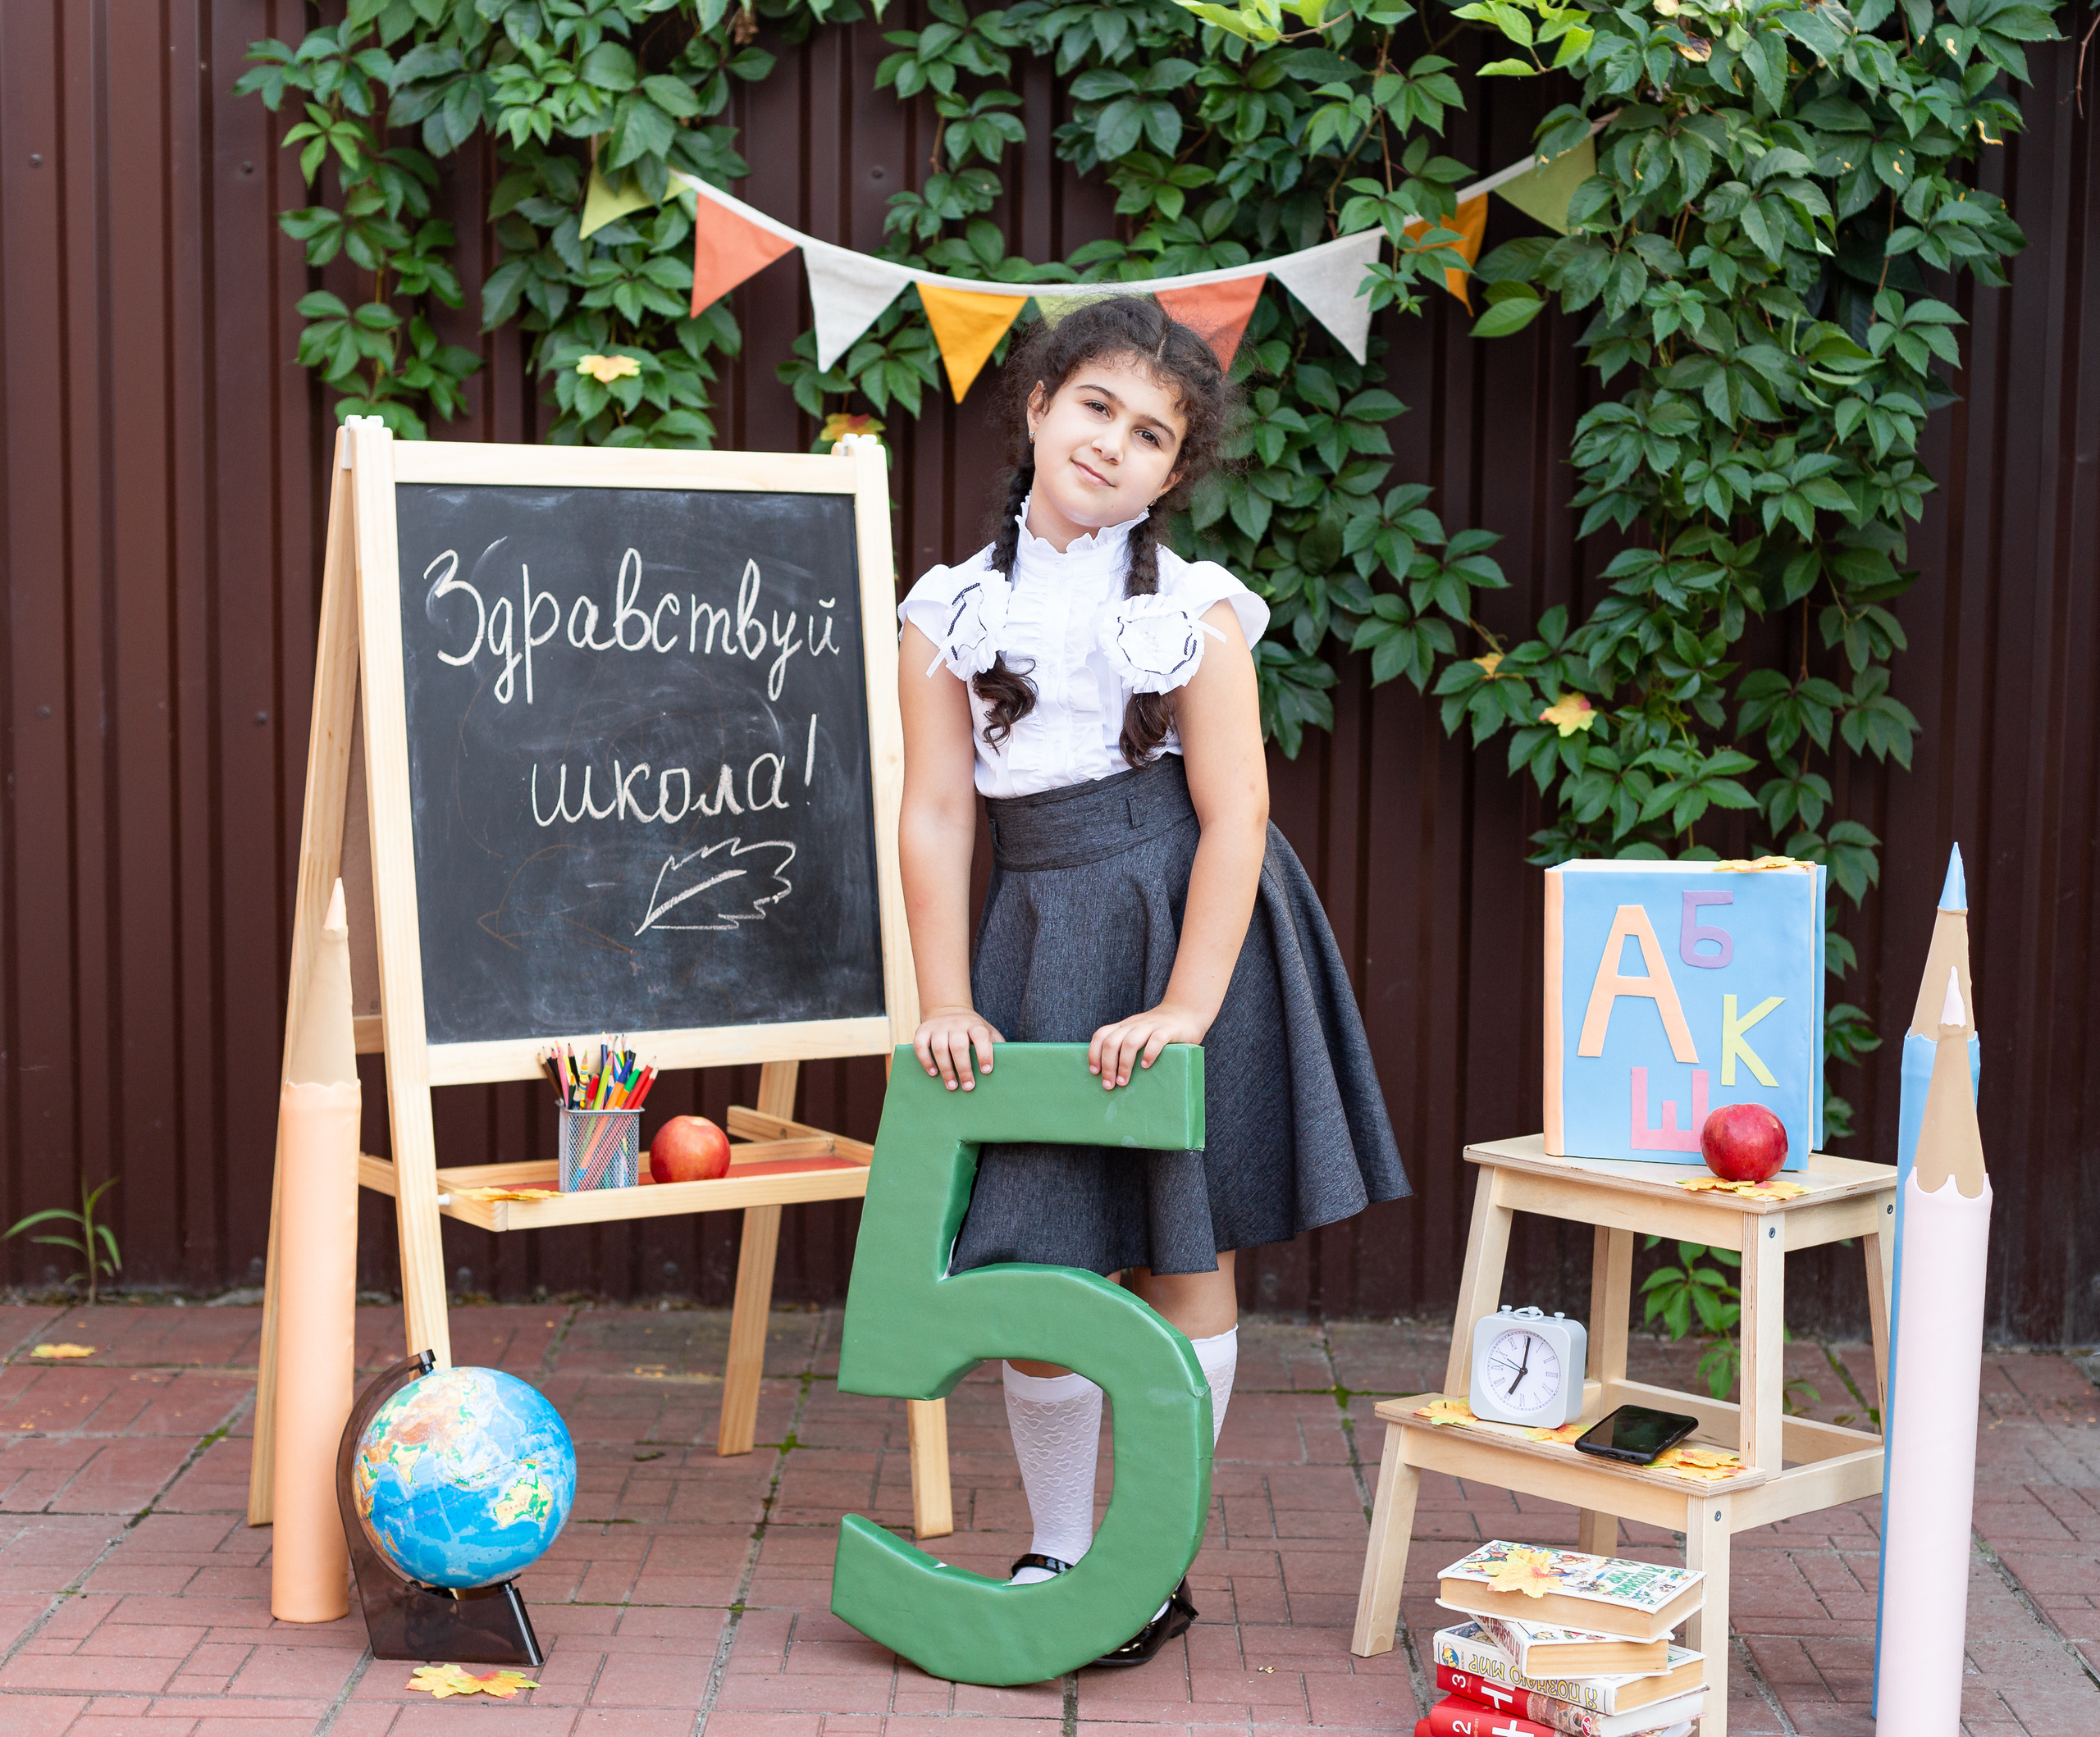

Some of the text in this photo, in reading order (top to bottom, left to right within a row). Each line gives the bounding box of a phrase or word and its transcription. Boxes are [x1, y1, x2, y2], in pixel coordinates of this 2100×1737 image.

[423, 547, 839, 704] Здравствуй
[531, 713, 817, 827] школа!
[1679, 890, 1733, 969] Б
[1577, 905, 1700, 1064] А
[1721, 994, 1787, 1087] К
[1630, 1066, 1710, 1152] Ш
[831, 1041, 1213, 1687] 5
[1452, 1674, 1466, 1689] 3
[1468, 1653, 1505, 1681] МИР
[1584, 1687, 1598, 1710] Я
[1452, 1720, 1472, 1735] 2
